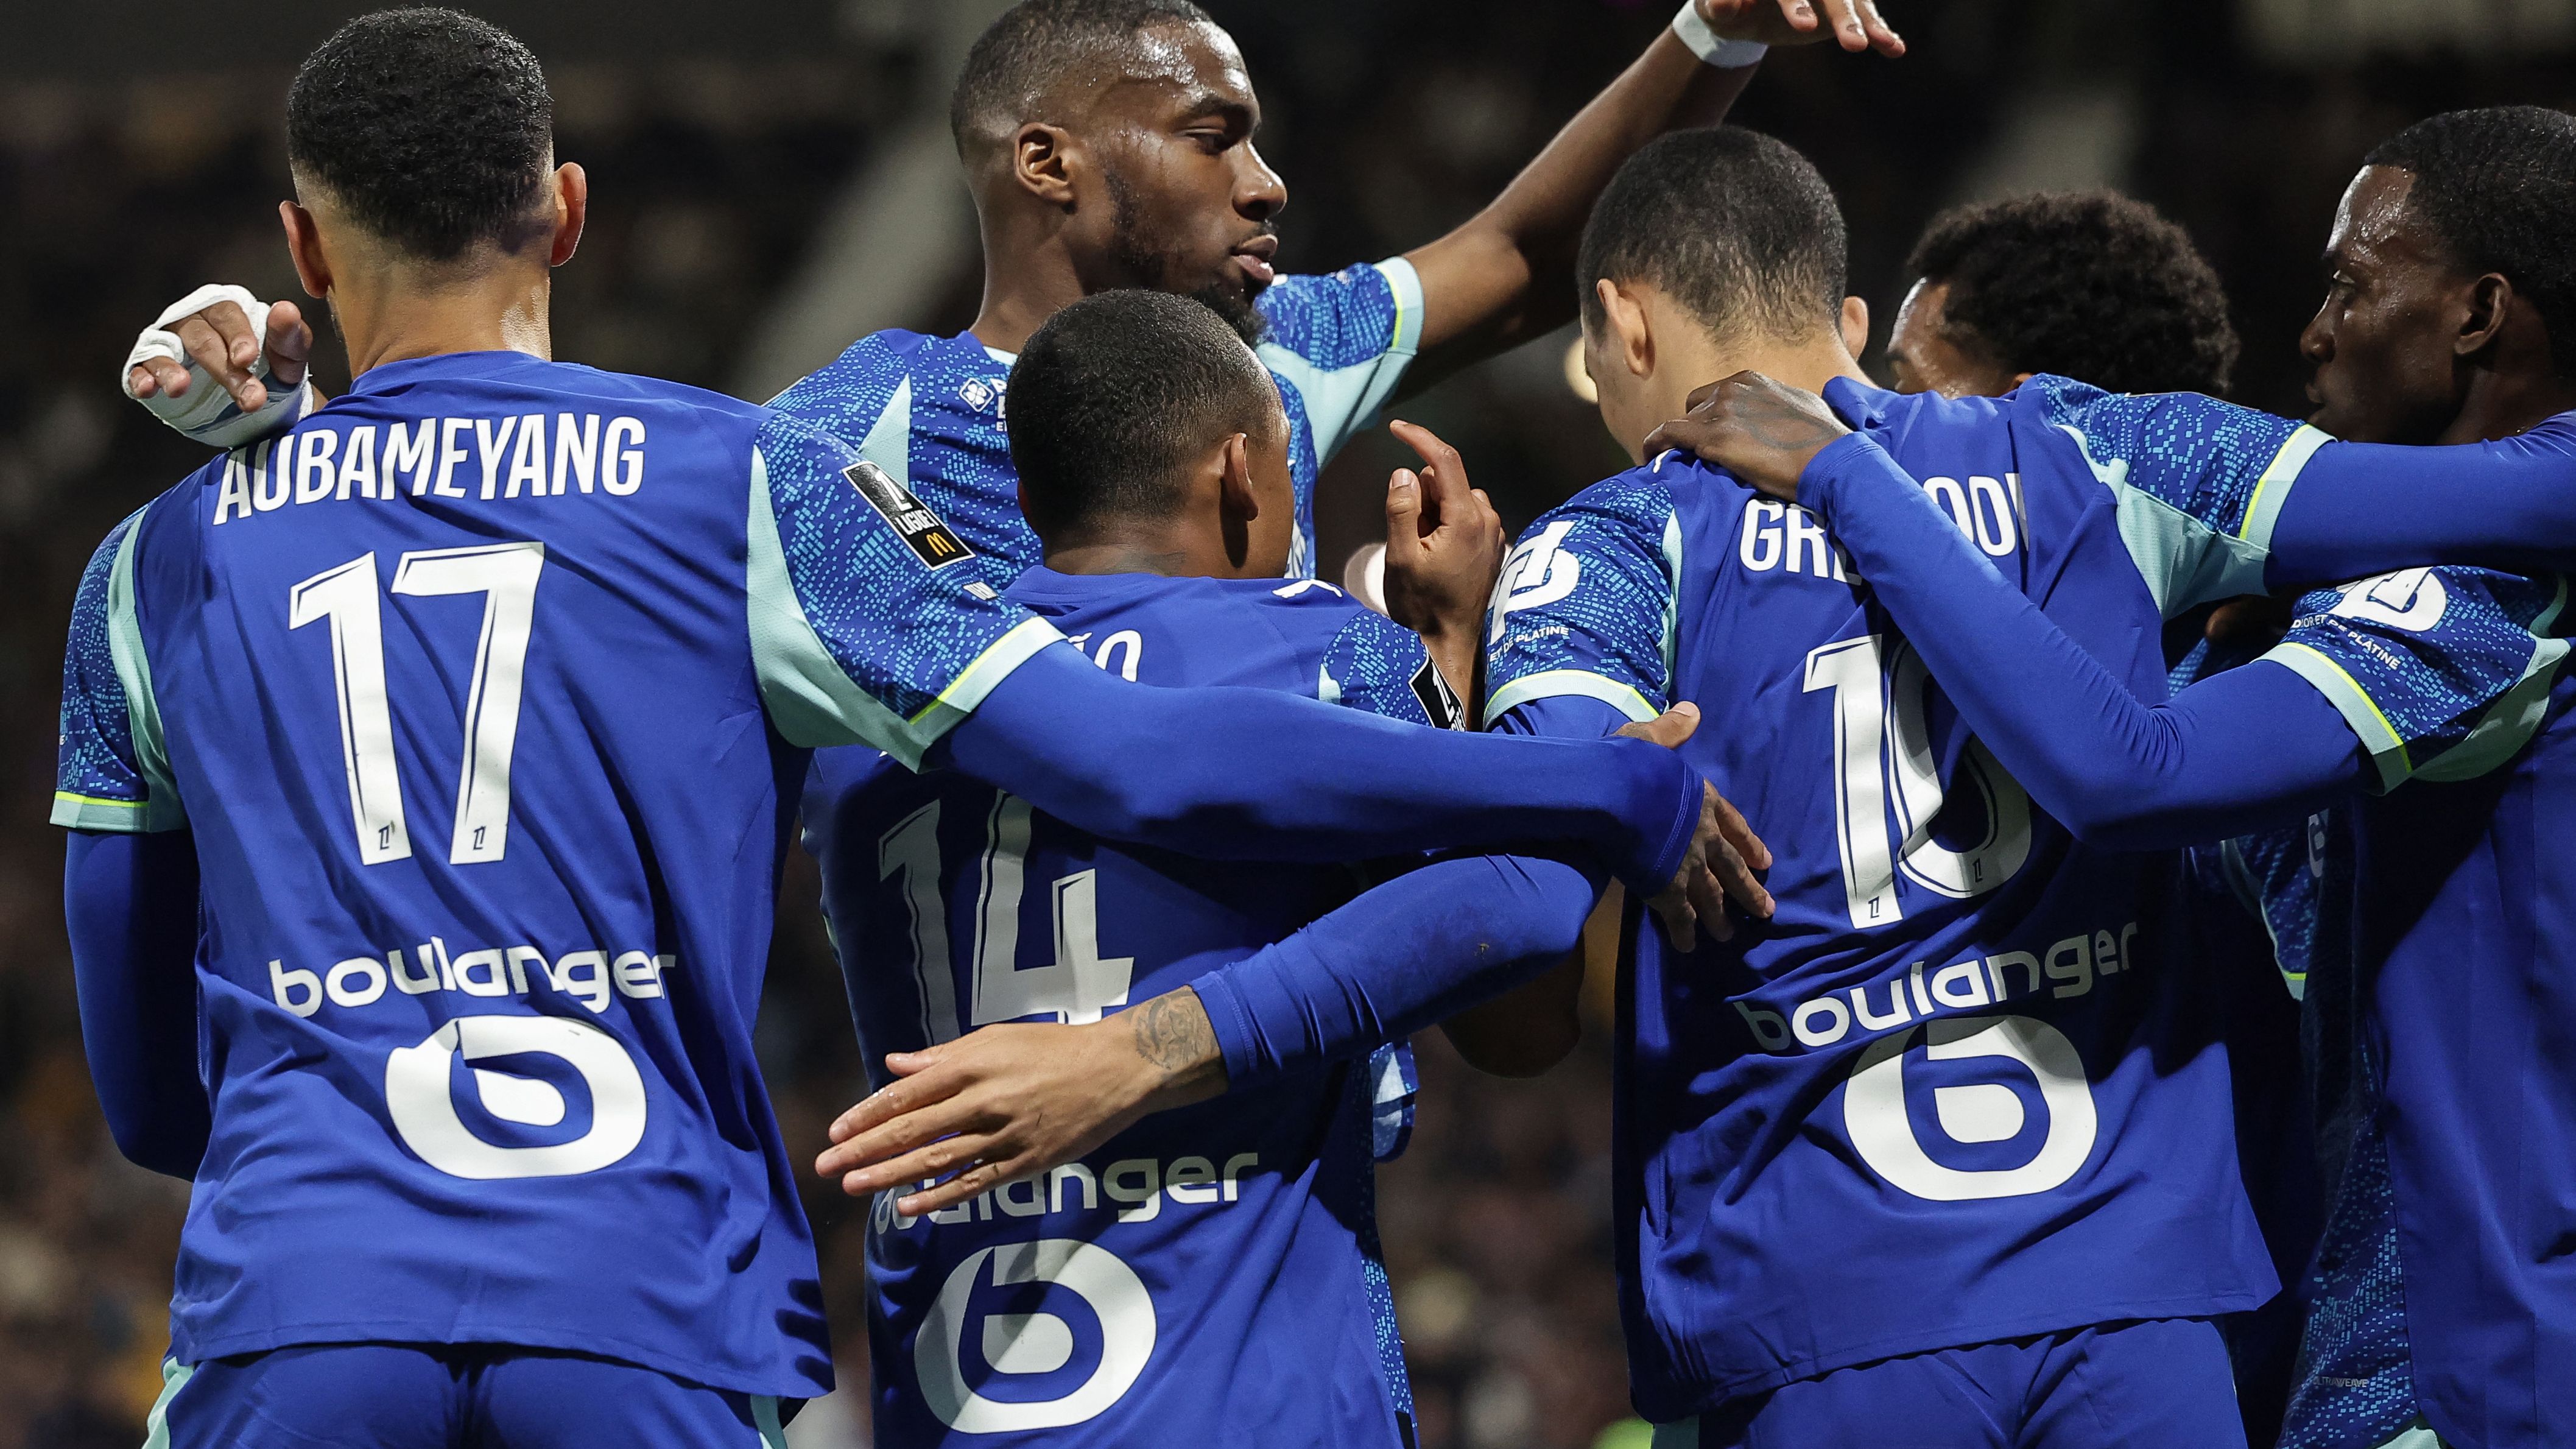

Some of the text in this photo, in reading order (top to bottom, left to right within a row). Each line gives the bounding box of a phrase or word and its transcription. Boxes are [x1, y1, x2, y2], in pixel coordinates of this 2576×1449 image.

[213, 412, 646, 526] AUBAMEYANG
[1490, 626, 1569, 662] ET DE PLATINE
[2315, 614, 2328, 626] ET
[2348, 631, 2401, 670] PLATINE
[289, 541, 544, 866] 17
[879, 788, 1134, 1044] 14
[269, 936, 676, 1018] boulanger
[1734, 922, 2138, 1051] boulanger
